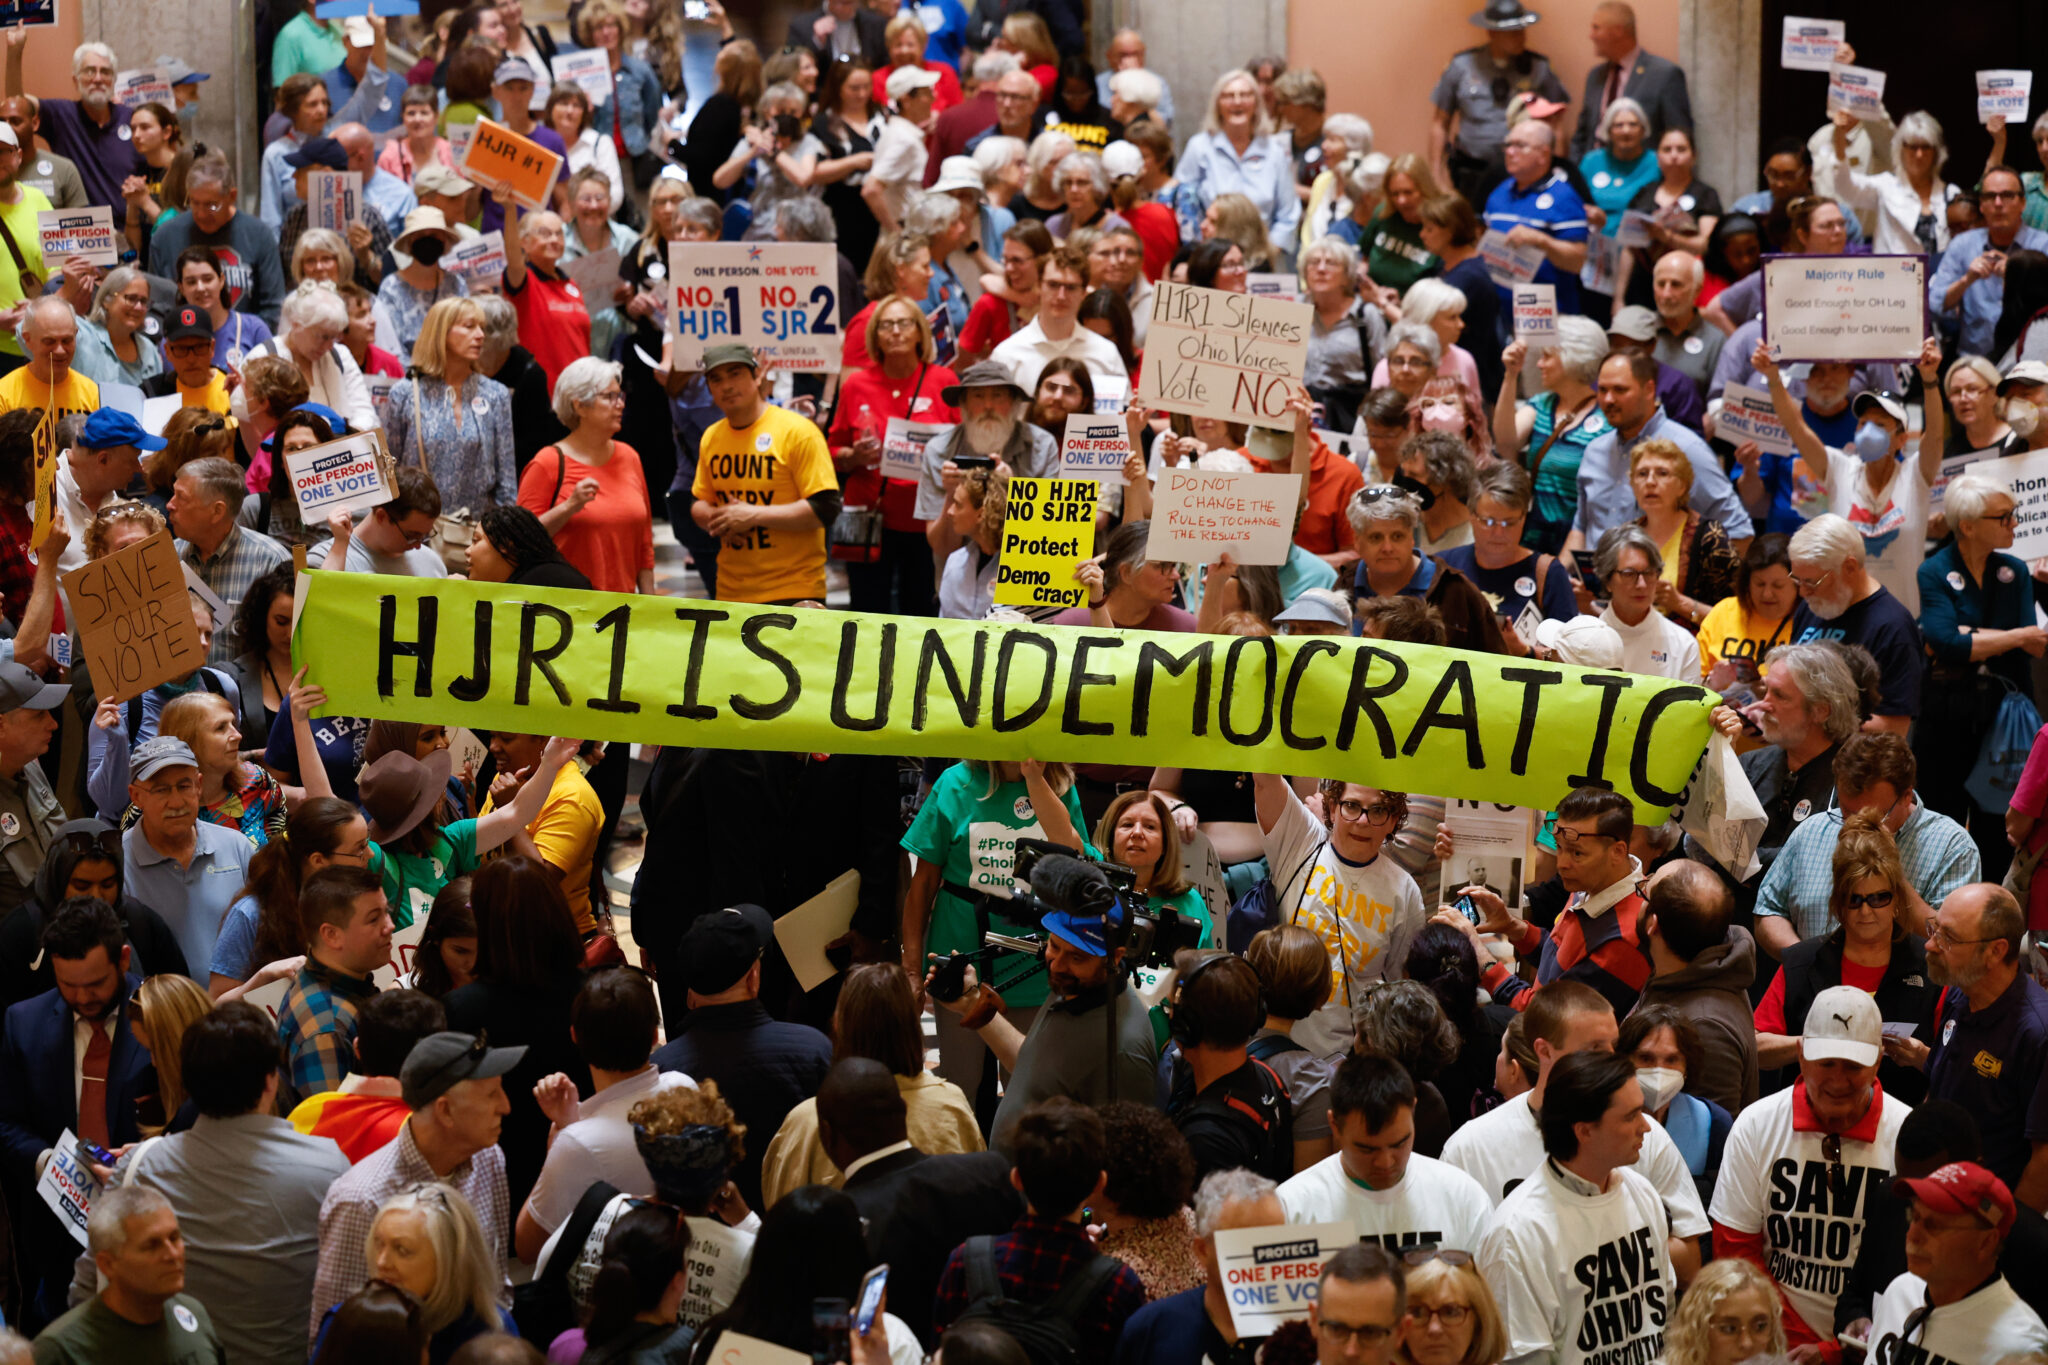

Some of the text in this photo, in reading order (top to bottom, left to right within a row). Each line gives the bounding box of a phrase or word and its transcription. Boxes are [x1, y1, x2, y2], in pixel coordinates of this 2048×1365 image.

[476, 130, 519, 162] HJR
[522, 154, 545, 175] #1
[43, 227, 110, 240] ONE PERSON
[44, 237, 112, 252] ONE VOTE
[694, 266, 820, 277] ONE PERSON. ONE VOTE.
[1805, 268, 1885, 282] Majority Rule
[676, 286, 714, 308] NO
[759, 285, 797, 308] NO
[1785, 298, 1906, 309] Good Enough for OH Leg
[1153, 283, 1301, 343] HJR1 Silences
[1781, 325, 1911, 336] Good Enough for OH Voters
[1178, 333, 1292, 377] Ohio Voices
[1158, 359, 1291, 418] Vote NO
[1094, 399, 1118, 411] OTE
[1723, 402, 1746, 417] ONE
[1088, 427, 1118, 437] PROTECT
[1721, 412, 1790, 440] ONE VOTE
[1067, 439, 1090, 450] ONE
[315, 453, 351, 471] PROTECT
[710, 454, 777, 480] COUNT
[886, 450, 916, 464] ONE
[1065, 452, 1095, 465] ONE
[297, 461, 375, 489] ONE PERSON
[1171, 474, 1239, 492] DO NOT
[300, 472, 378, 503] ONE VOTE
[1011, 480, 1098, 502] NO HJR1
[1183, 495, 1277, 512] CHANGE THE
[2026, 495, 2040, 505] all
[1006, 501, 1092, 522] NO SJR2
[1167, 510, 1217, 528] RULES
[1005, 534, 1079, 557] Protect
[1169, 529, 1251, 541] THE RESULTS
[78, 540, 171, 625] SAVE
[997, 565, 1051, 586] Demo
[1033, 587, 1085, 608] cracy
[113, 599, 169, 645] OUR
[57, 638, 70, 665] ONE
[98, 621, 190, 693] VOTE
[978, 855, 1014, 869] Choi
[977, 872, 1016, 887] Ohio
[1304, 864, 1393, 934] COUNT
[55, 1151, 95, 1201] VOTE
[51, 1165, 91, 1214] ERSON
[1766, 1213, 1862, 1262] OHIO'
[1256, 1243, 1316, 1260] PROTECT
[687, 1257, 716, 1278] nge
[1227, 1263, 1326, 1285] ONE PERS
[1574, 1227, 1661, 1309] SAVE
[688, 1277, 713, 1298] Law
[1232, 1283, 1318, 1306] ONE VO
[681, 1298, 713, 1317] erties
